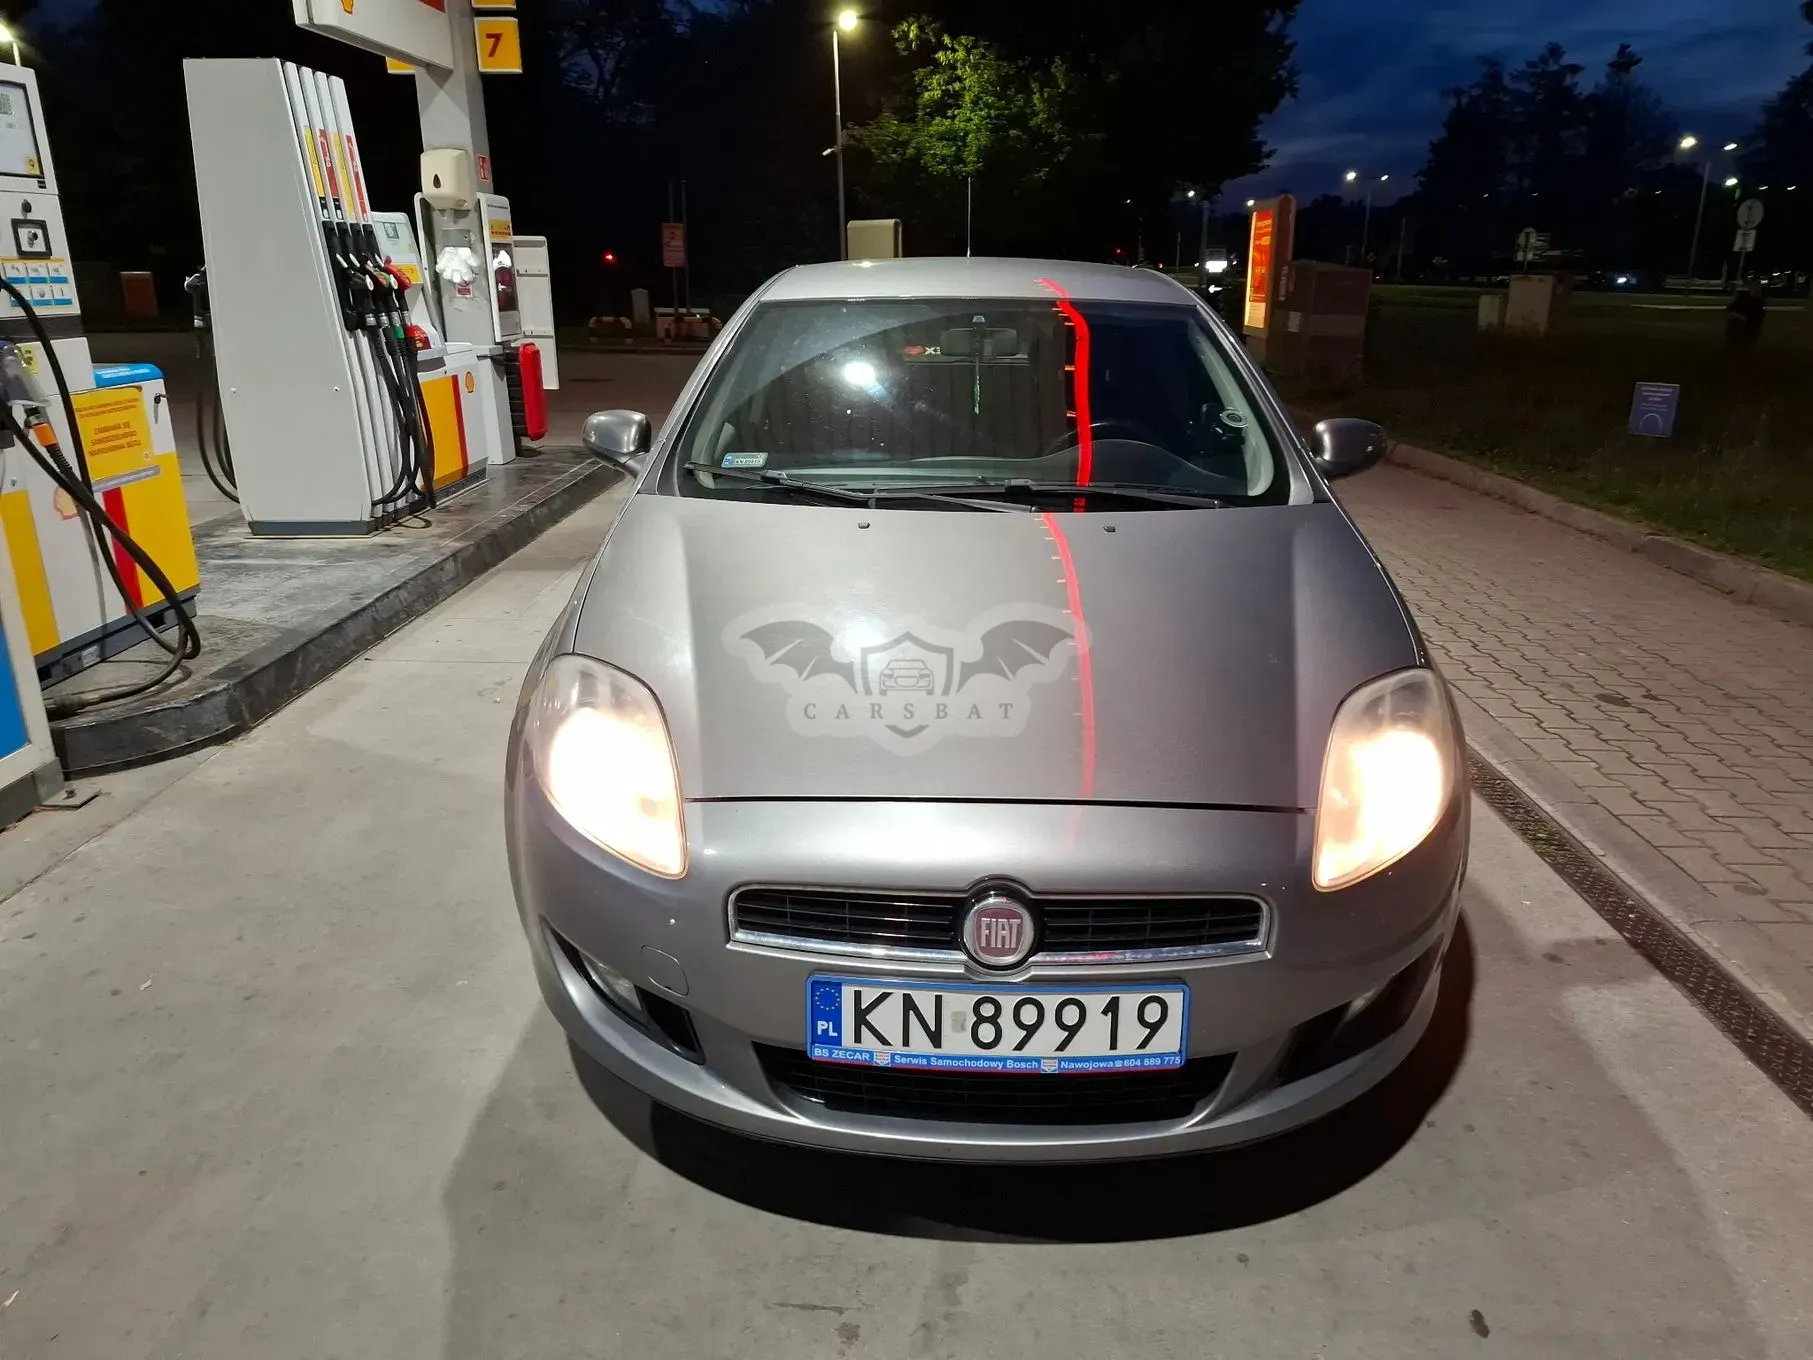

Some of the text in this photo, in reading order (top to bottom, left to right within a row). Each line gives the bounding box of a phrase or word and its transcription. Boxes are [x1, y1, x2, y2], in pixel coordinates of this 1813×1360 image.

[485, 33, 503, 58] 7
[980, 917, 1021, 949] FIAT
[817, 1021, 838, 1037] PL
[853, 990, 1169, 1052] KN 89919
[814, 1048, 830, 1057] BS
[832, 1050, 870, 1061] ZECAR
[894, 1055, 927, 1065] Serwis
[930, 1057, 1004, 1069] Samochodowy
[1007, 1060, 1038, 1069] Bosch
[1060, 1060, 1114, 1070] Nawojowa
[1124, 1059, 1141, 1067] 604
[1143, 1057, 1161, 1067] 889
[1164, 1056, 1181, 1065] 775
